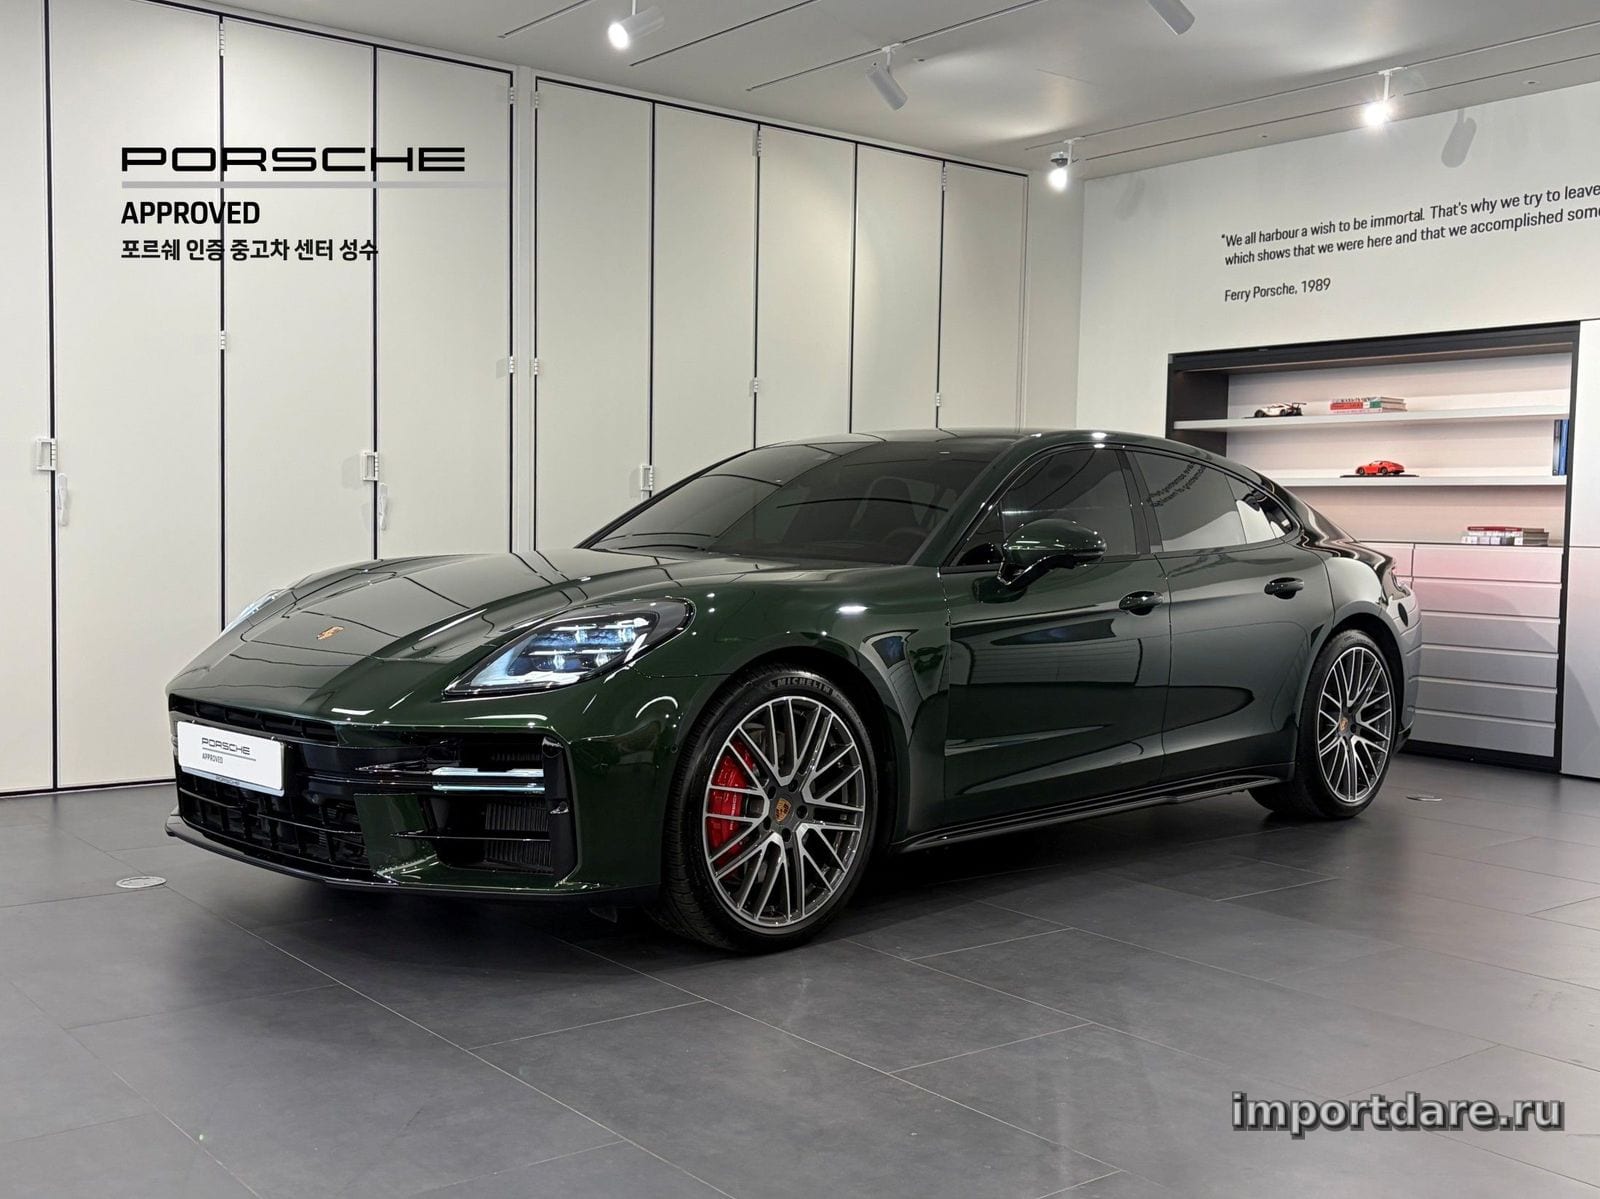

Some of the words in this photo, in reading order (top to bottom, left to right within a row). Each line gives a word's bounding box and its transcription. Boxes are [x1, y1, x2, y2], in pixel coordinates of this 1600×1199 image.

[121, 146, 466, 172] PORSCHE
[120, 201, 261, 225] APPROVED
[1244, 231, 1257, 246] all
[1259, 228, 1300, 243] harbour
[1301, 227, 1308, 237] a
[1310, 220, 1336, 236] wish
[1338, 220, 1351, 232] to
[1353, 217, 1368, 231] be
[1370, 207, 1425, 228] immortal.
[1430, 201, 1468, 219] That's
[1470, 197, 1497, 215] why
[1500, 196, 1520, 209] we
[1523, 193, 1543, 208] try
[1546, 189, 1561, 202] to
[1564, 184, 1600, 200] leave
[1225, 250, 1255, 266] which
[1257, 248, 1291, 262] shows
[1293, 244, 1315, 257] that
[1317, 243, 1334, 254] we
[1336, 239, 1364, 252] were
[1367, 235, 1393, 248] here
[1395, 228, 1417, 245] and
[1420, 226, 1446, 241] that
[1448, 224, 1468, 237] we
[1470, 207, 1564, 234] accomplished
[1567, 206, 1600, 221] som
[121, 238, 181, 261] 포르쉐
[186, 238, 225, 261] 인증
[230, 238, 290, 261] 중고차
[294, 238, 334, 261] 센터
[339, 238, 379, 261] 성수
[1224, 289, 1251, 303] Ferry
[1253, 282, 1298, 299] Porsche,
[1301, 277, 1331, 293] 1989
[777, 677, 831, 695] MICHELIN
[201, 737, 251, 756] PORSCHE
[202, 752, 223, 764] APPROVED
